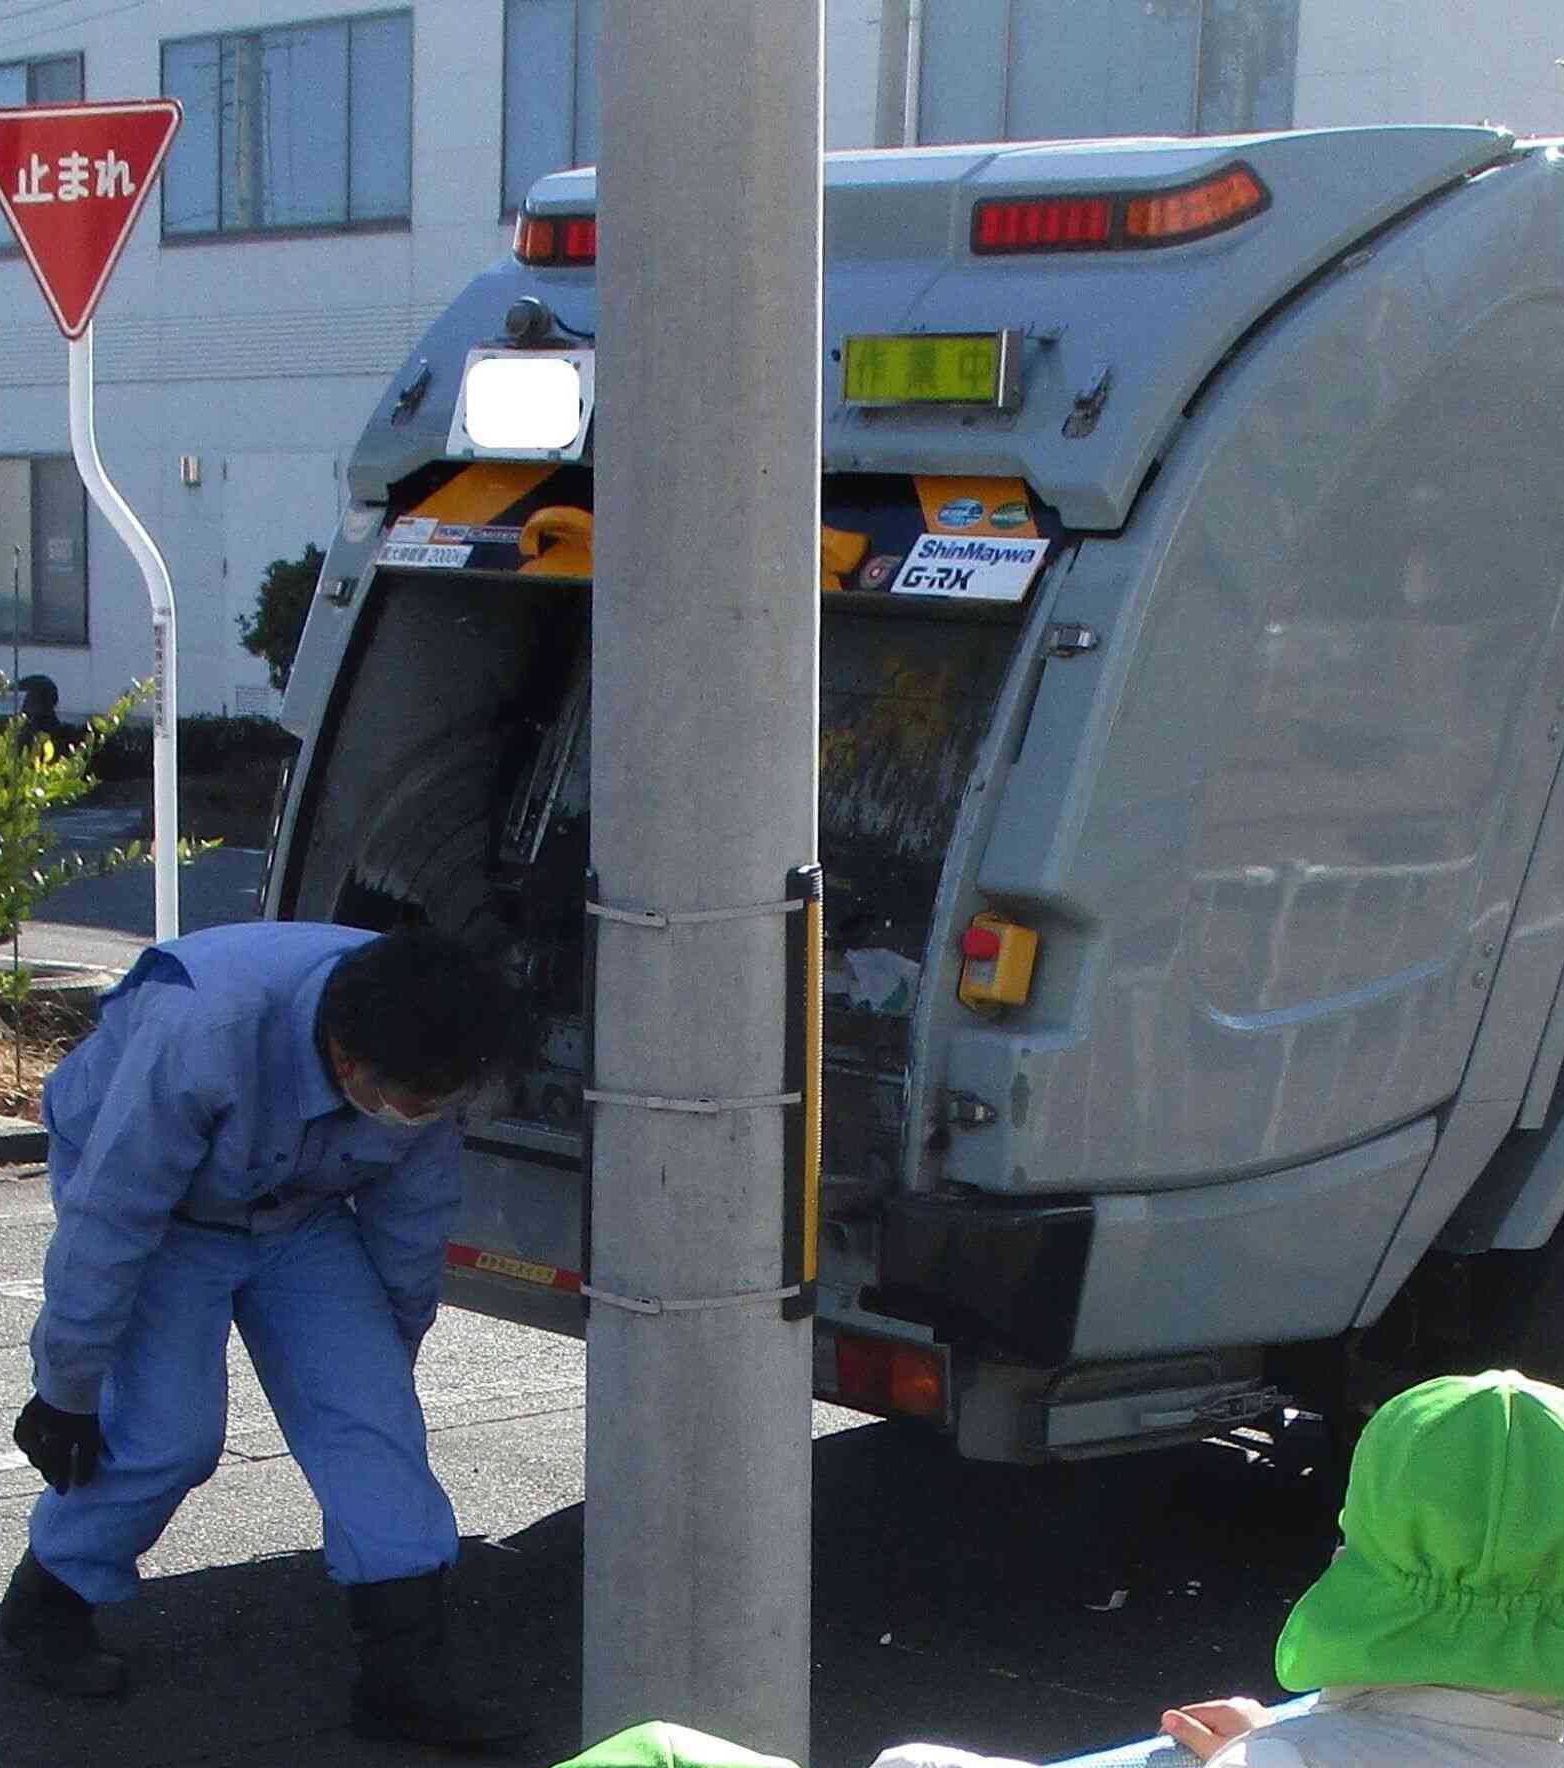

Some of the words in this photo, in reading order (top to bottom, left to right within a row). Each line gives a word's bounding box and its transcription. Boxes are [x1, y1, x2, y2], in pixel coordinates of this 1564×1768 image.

[12, 149, 136, 204] 止まれ
[917, 538, 1035, 566] ShinMaywa
[901, 566, 975, 591] G-RX
